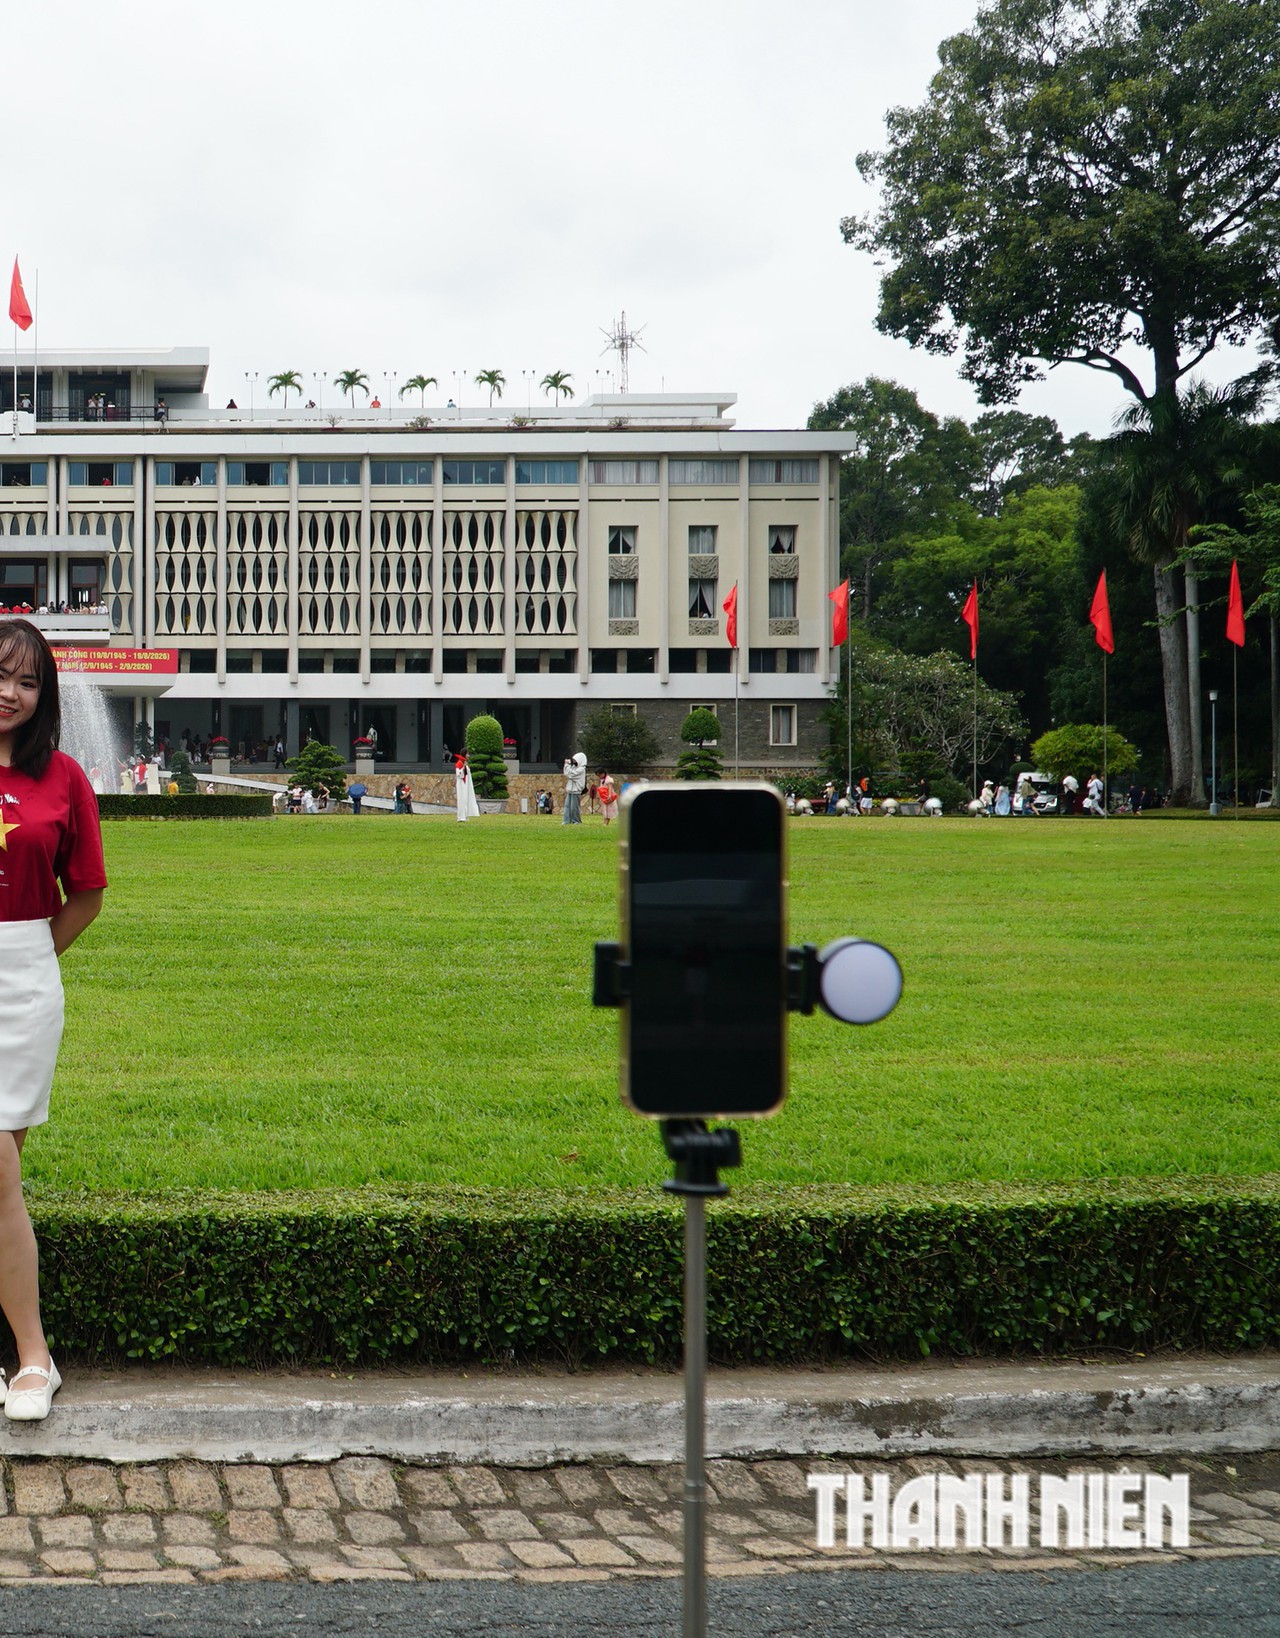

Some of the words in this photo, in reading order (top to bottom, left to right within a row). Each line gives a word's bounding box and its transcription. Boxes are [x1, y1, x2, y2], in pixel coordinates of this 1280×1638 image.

[89, 651, 127, 660] (19/8/1945
[133, 652, 170, 660] 19/8/2026)
[80, 661, 114, 670] (2/9/1945
[119, 662, 153, 671] 2/9/2026)
